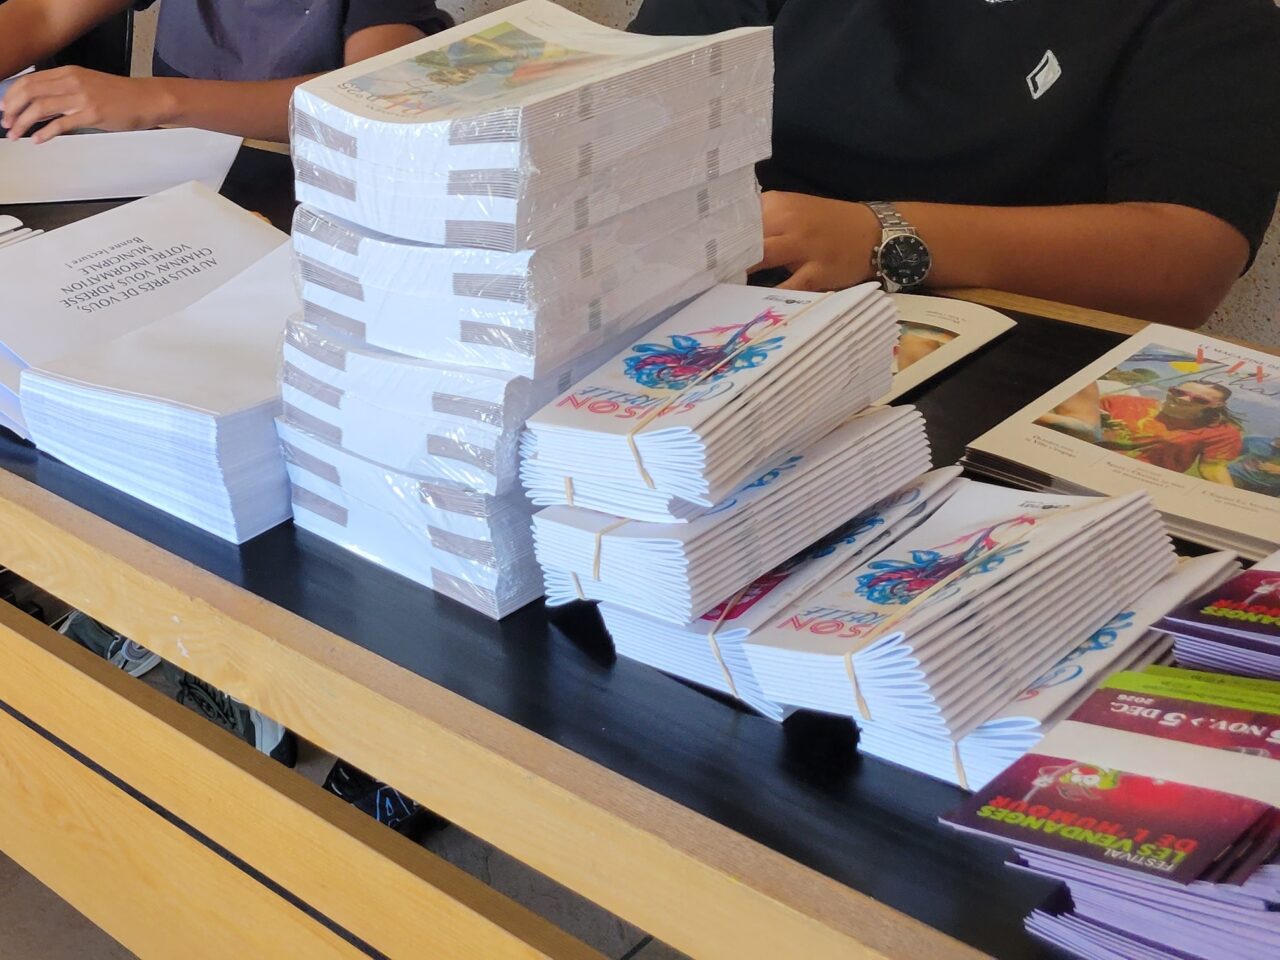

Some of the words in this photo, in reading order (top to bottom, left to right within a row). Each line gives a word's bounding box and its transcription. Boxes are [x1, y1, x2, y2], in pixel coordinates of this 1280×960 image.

[109, 236, 145, 252] Bonne
[151, 243, 193, 264] VOTRE
[72, 248, 110, 266] lecture
[77, 244, 154, 276] MUNICIPALE
[156, 247, 213, 274] CHARNAY
[201, 257, 219, 270] AU
[59, 258, 152, 295] INFORMATION
[116, 268, 156, 287] VOUS
[169, 264, 202, 282] PLUS
[59, 281, 116, 309] ADRESSE
[76, 295, 121, 314] VOUS,
[119, 289, 140, 300] DE
[1158, 712, 1187, 728] 5
[1208, 717, 1267, 737] NOV.
[976, 804, 1135, 853] VENDANGES
[1136, 843, 1189, 865] LES
[1156, 833, 1200, 855] DE
[1104, 846, 1176, 873] FESTIVAL
